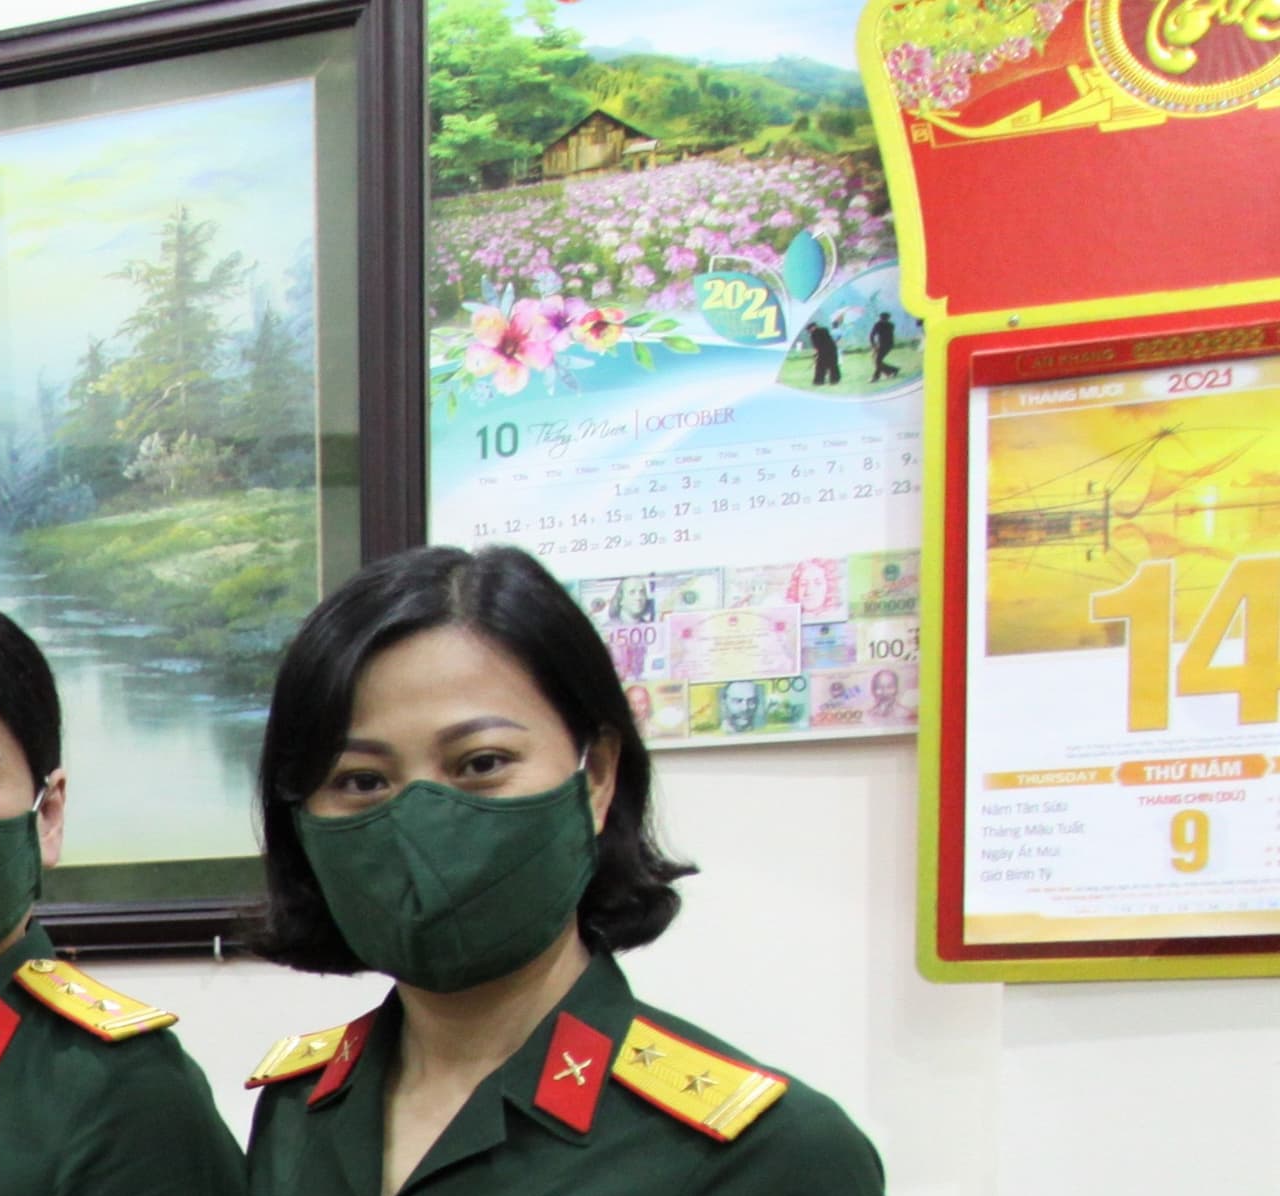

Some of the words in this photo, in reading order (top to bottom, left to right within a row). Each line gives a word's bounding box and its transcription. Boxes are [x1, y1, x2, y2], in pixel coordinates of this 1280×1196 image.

[702, 278, 782, 340] 2021
[1167, 367, 1234, 394] 2021
[475, 420, 519, 460] 10
[645, 407, 736, 432] OCTOBER
[648, 479, 658, 494] 2
[681, 476, 692, 490] 3
[719, 472, 729, 485] 4
[757, 468, 767, 482] 5
[791, 464, 801, 478] 6
[827, 460, 837, 474] 7
[863, 456, 873, 471] 8
[902, 451, 912, 467] 9
[475, 523, 489, 537] 11
[505, 519, 521, 533] 12
[539, 516, 555, 530] 13
[571, 512, 588, 527] 14
[606, 509, 622, 523] 15
[641, 505, 658, 520] 16
[674, 501, 691, 517] 17
[712, 499, 729, 513] 18
[749, 495, 766, 510] 19
[781, 492, 801, 506] 20
[818, 488, 836, 503] 21
[854, 484, 873, 499] 22
[892, 480, 912, 495] 23
[538, 542, 554, 556] 27
[570, 538, 588, 553] 28
[604, 535, 622, 550] 29
[640, 532, 658, 545] 30
[673, 528, 690, 543] 31
[868, 638, 905, 660] 100
[1089, 553, 1280, 733] 14
[1016, 770, 1099, 785] THURSDAY
[1143, 762, 1188, 781] THỨ
[1169, 808, 1211, 873] 9
